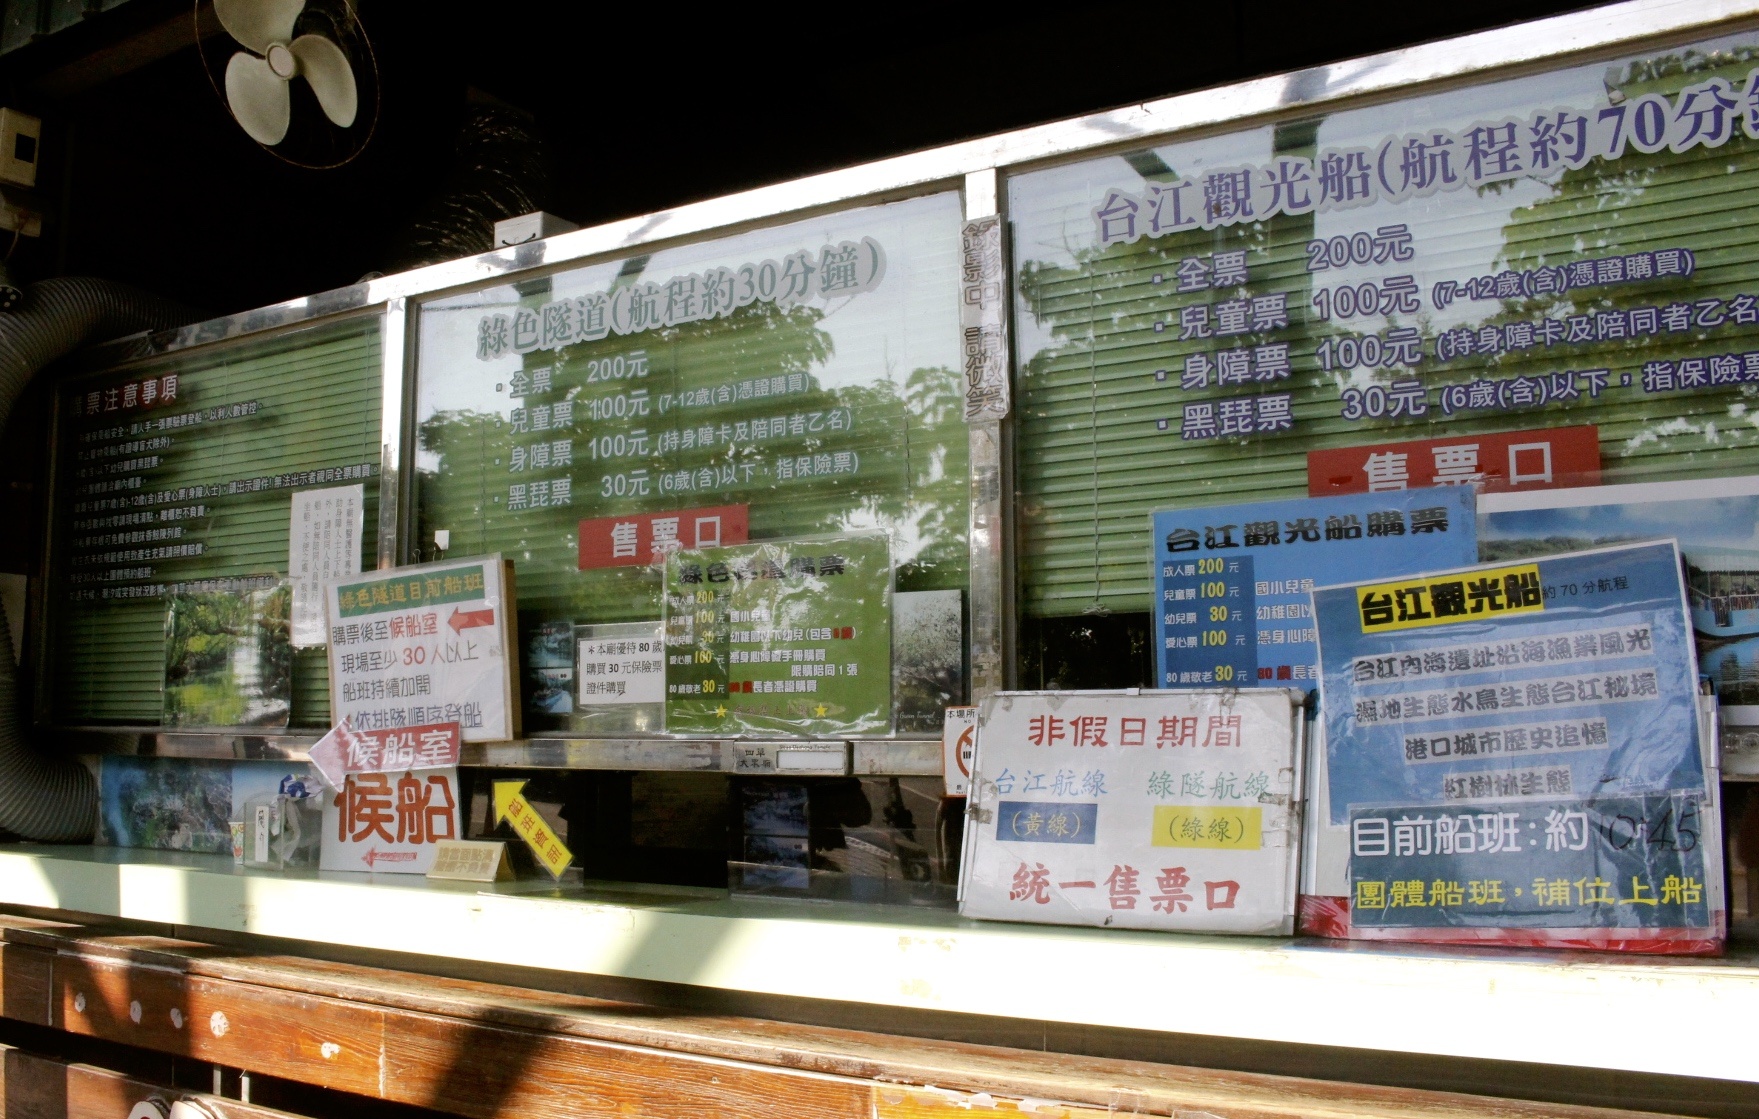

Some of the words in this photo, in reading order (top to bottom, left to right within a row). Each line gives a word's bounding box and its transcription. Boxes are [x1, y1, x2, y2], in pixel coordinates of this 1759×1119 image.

[962, 220, 1001, 310] 錄影中
[1177, 251, 1247, 291] 全票
[1307, 224, 1414, 271] 200元
[478, 240, 879, 357] 綠色隧道(航程約30分鐘)
[1180, 293, 1288, 340] 兒童票
[1313, 275, 1420, 320] 100元
[1432, 250, 1695, 310] (7-12歲(含)憑證購買)
[509, 366, 552, 398] 全票
[587, 350, 649, 383] 200元
[1182, 343, 1291, 389] 身障票
[1317, 327, 1423, 372] 100元
[509, 401, 574, 435] 兒童票
[590, 389, 649, 421] 100元
[658, 373, 810, 414] (7-12歲(含)憑證購買)
[1182, 394, 1292, 439] 黑琵票
[1342, 380, 1426, 420] 30元
[508, 439, 573, 473] 身障票
[588, 431, 649, 461] 100元
[658, 410, 852, 455] (持身障卡及陪同者乙名)
[1362, 442, 1553, 493] 售票口
[508, 477, 572, 511] 黑琵票
[601, 470, 650, 498] 30元
[610, 516, 721, 558] 售票口
[1166, 506, 1449, 552] 台江觀光船購票
[1163, 564, 1195, 577] 成人票
[1198, 558, 1224, 574] 200
[1229, 562, 1240, 573] 元
[696, 591, 714, 604] 200
[1164, 589, 1196, 601] 兒童票
[1201, 582, 1225, 598] 100
[1229, 586, 1240, 597] 元
[1361, 572, 1540, 626] 台江觀光船
[1560, 584, 1577, 597] 70
[1583, 576, 1629, 596] 分航程
[333, 613, 438, 646] 購票後至候船室
[1164, 613, 1197, 624] 幼兒票
[1210, 606, 1228, 622] 30
[1232, 611, 1242, 621] 元
[342, 650, 398, 674] 現場至少
[402, 646, 426, 666] 30
[431, 641, 479, 665] 人以上
[1165, 637, 1198, 649] 愛心票
[1202, 630, 1227, 646] 100
[1235, 635, 1246, 646] 元
[586, 662, 606, 675] 購買
[608, 664, 619, 673] 30
[621, 661, 662, 674] 元保險票
[702, 680, 715, 692] 30
[1166, 673, 1178, 683] 80
[1215, 665, 1233, 681] 30
[1237, 671, 1248, 681] 元
[343, 674, 431, 702] 船班持續加開
[586, 681, 626, 695] 證件購買
[355, 702, 483, 729] 依排隊順序登船
[1028, 715, 1242, 749] 非假日期間
[347, 729, 452, 767] 候船室
[1405, 721, 1608, 760] 港口城市歷史追憶
[995, 768, 1108, 797] 台江航線
[1146, 771, 1271, 800] 綠隧航線
[334, 771, 455, 844] 候船
[1012, 812, 1082, 838] (黃線)
[1169, 815, 1244, 842] (綠線)
[1010, 862, 1241, 914] 統一售票口
